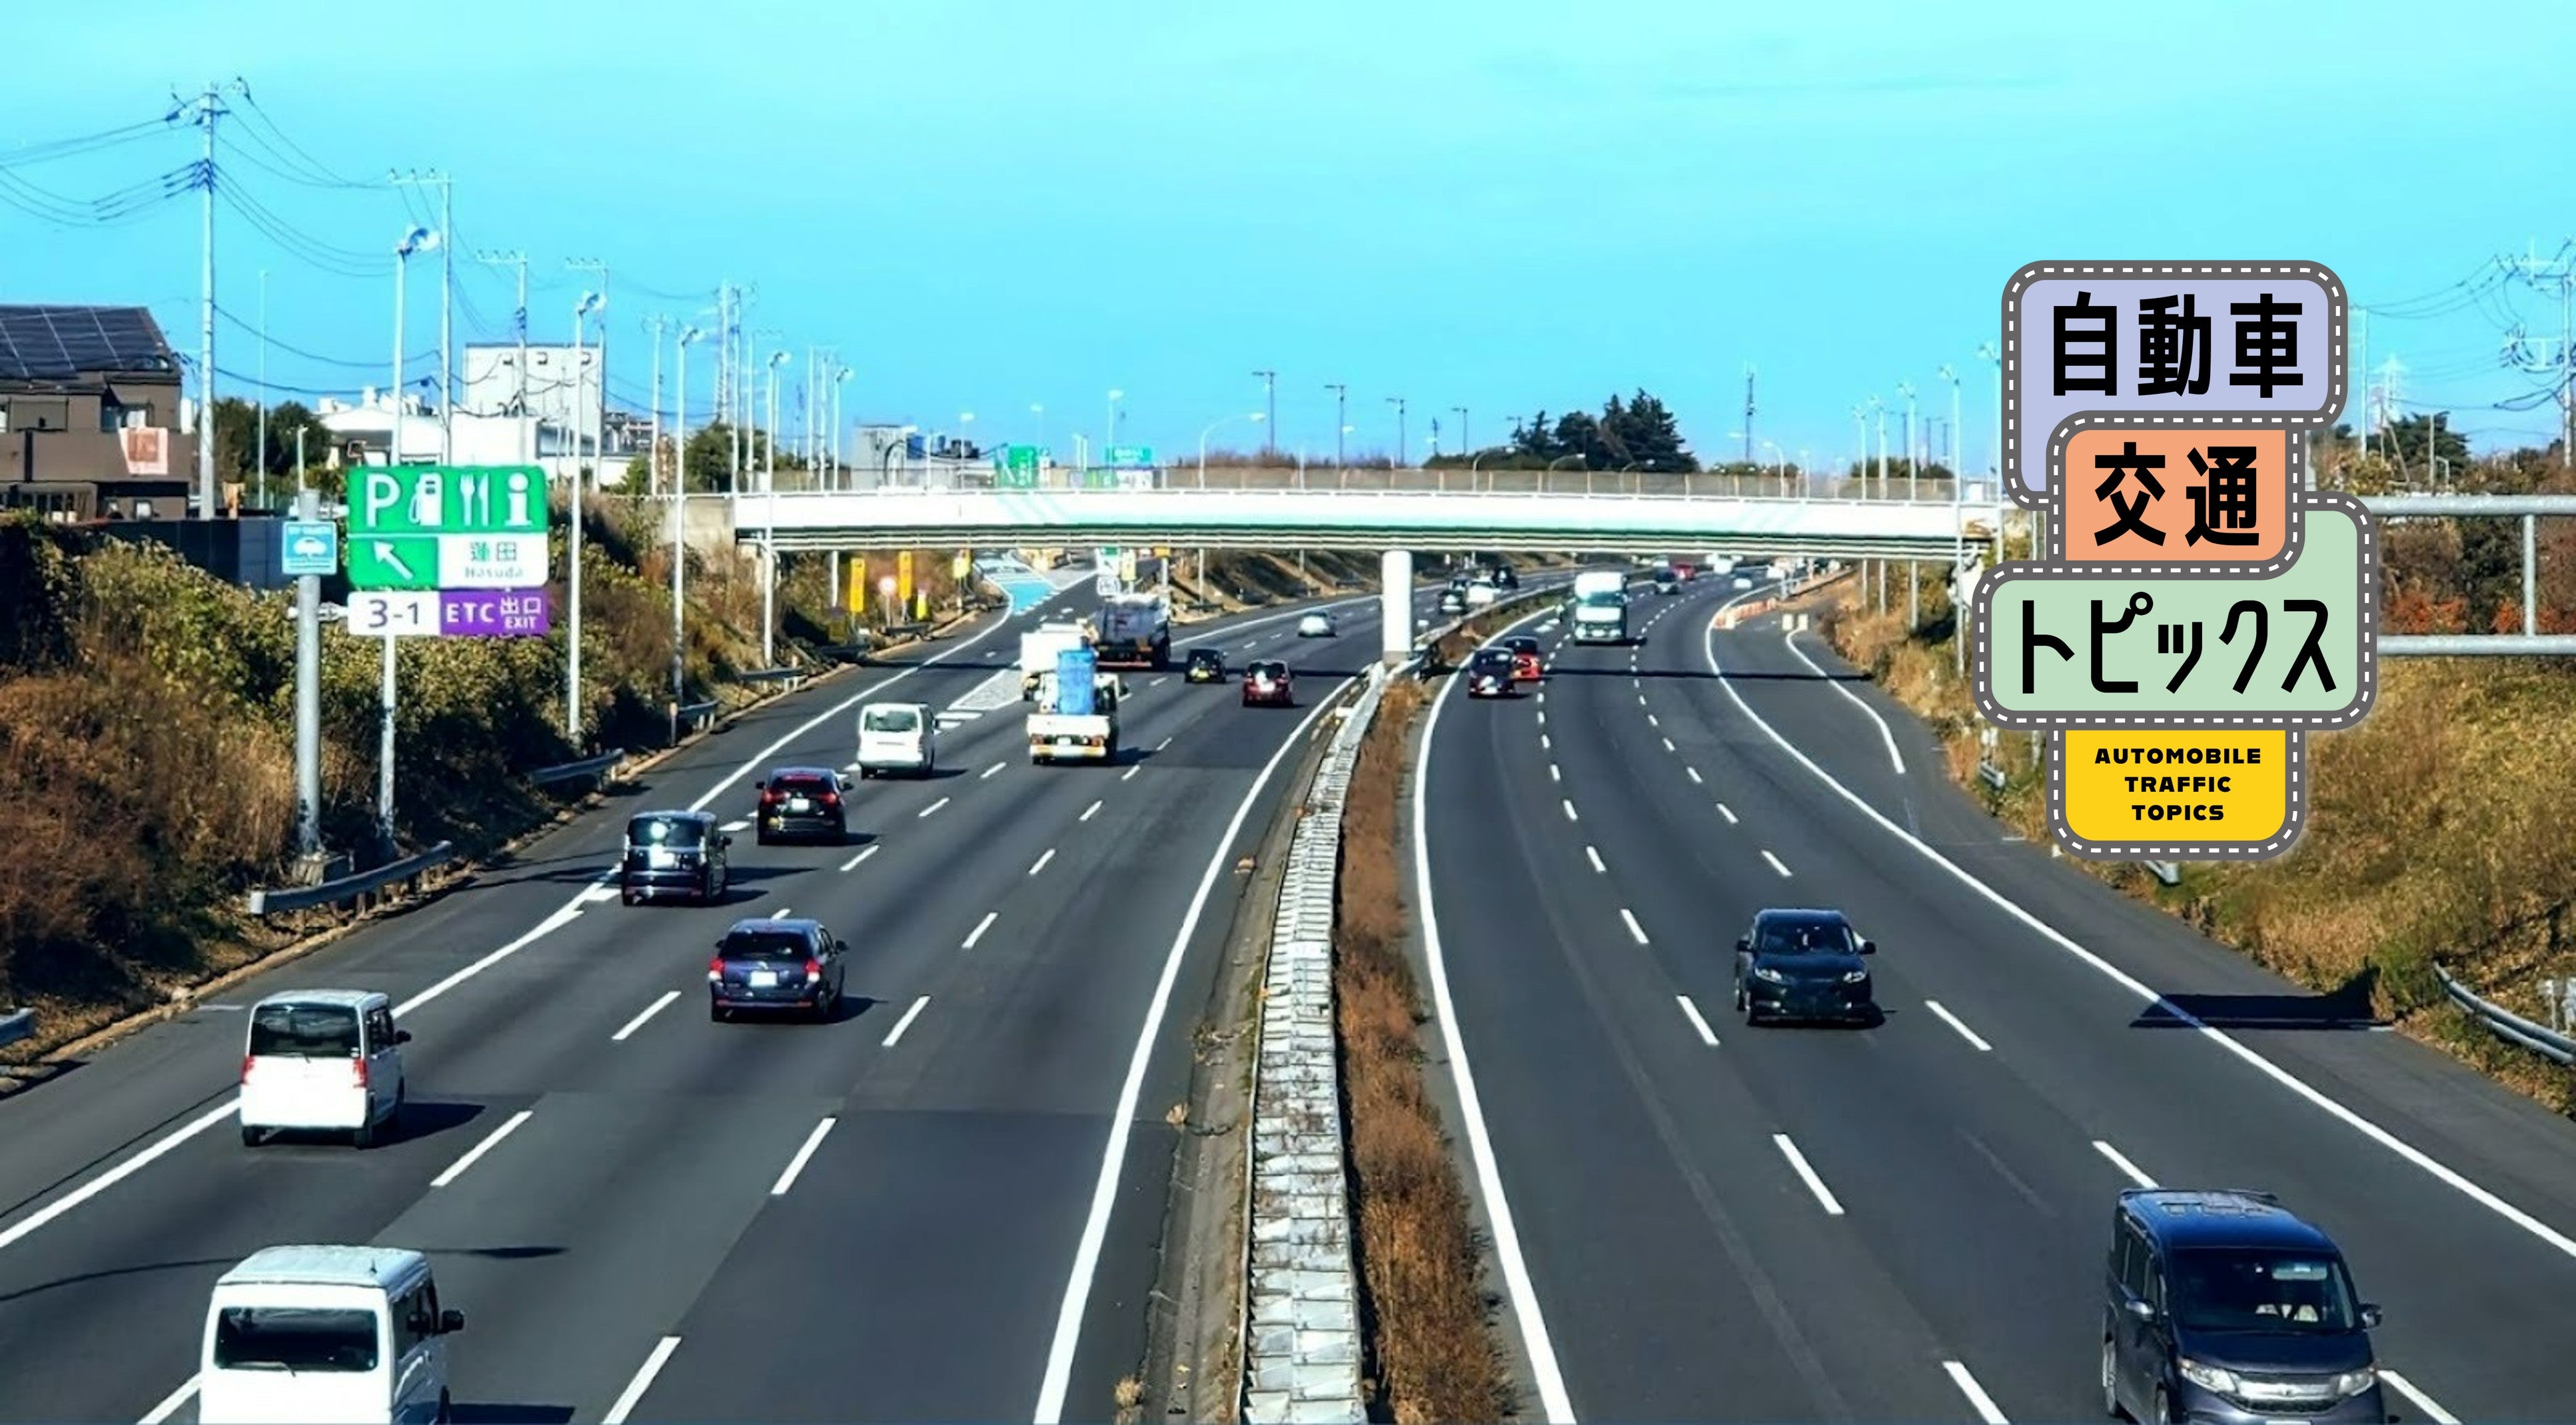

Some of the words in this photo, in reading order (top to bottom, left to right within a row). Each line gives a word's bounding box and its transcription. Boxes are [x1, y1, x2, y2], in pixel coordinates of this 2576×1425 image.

[367, 473, 400, 527] P
[368, 600, 418, 628] 3-1
[446, 603, 495, 623] ETC
[500, 597, 541, 615] 出口
[505, 616, 537, 629] EXIT
